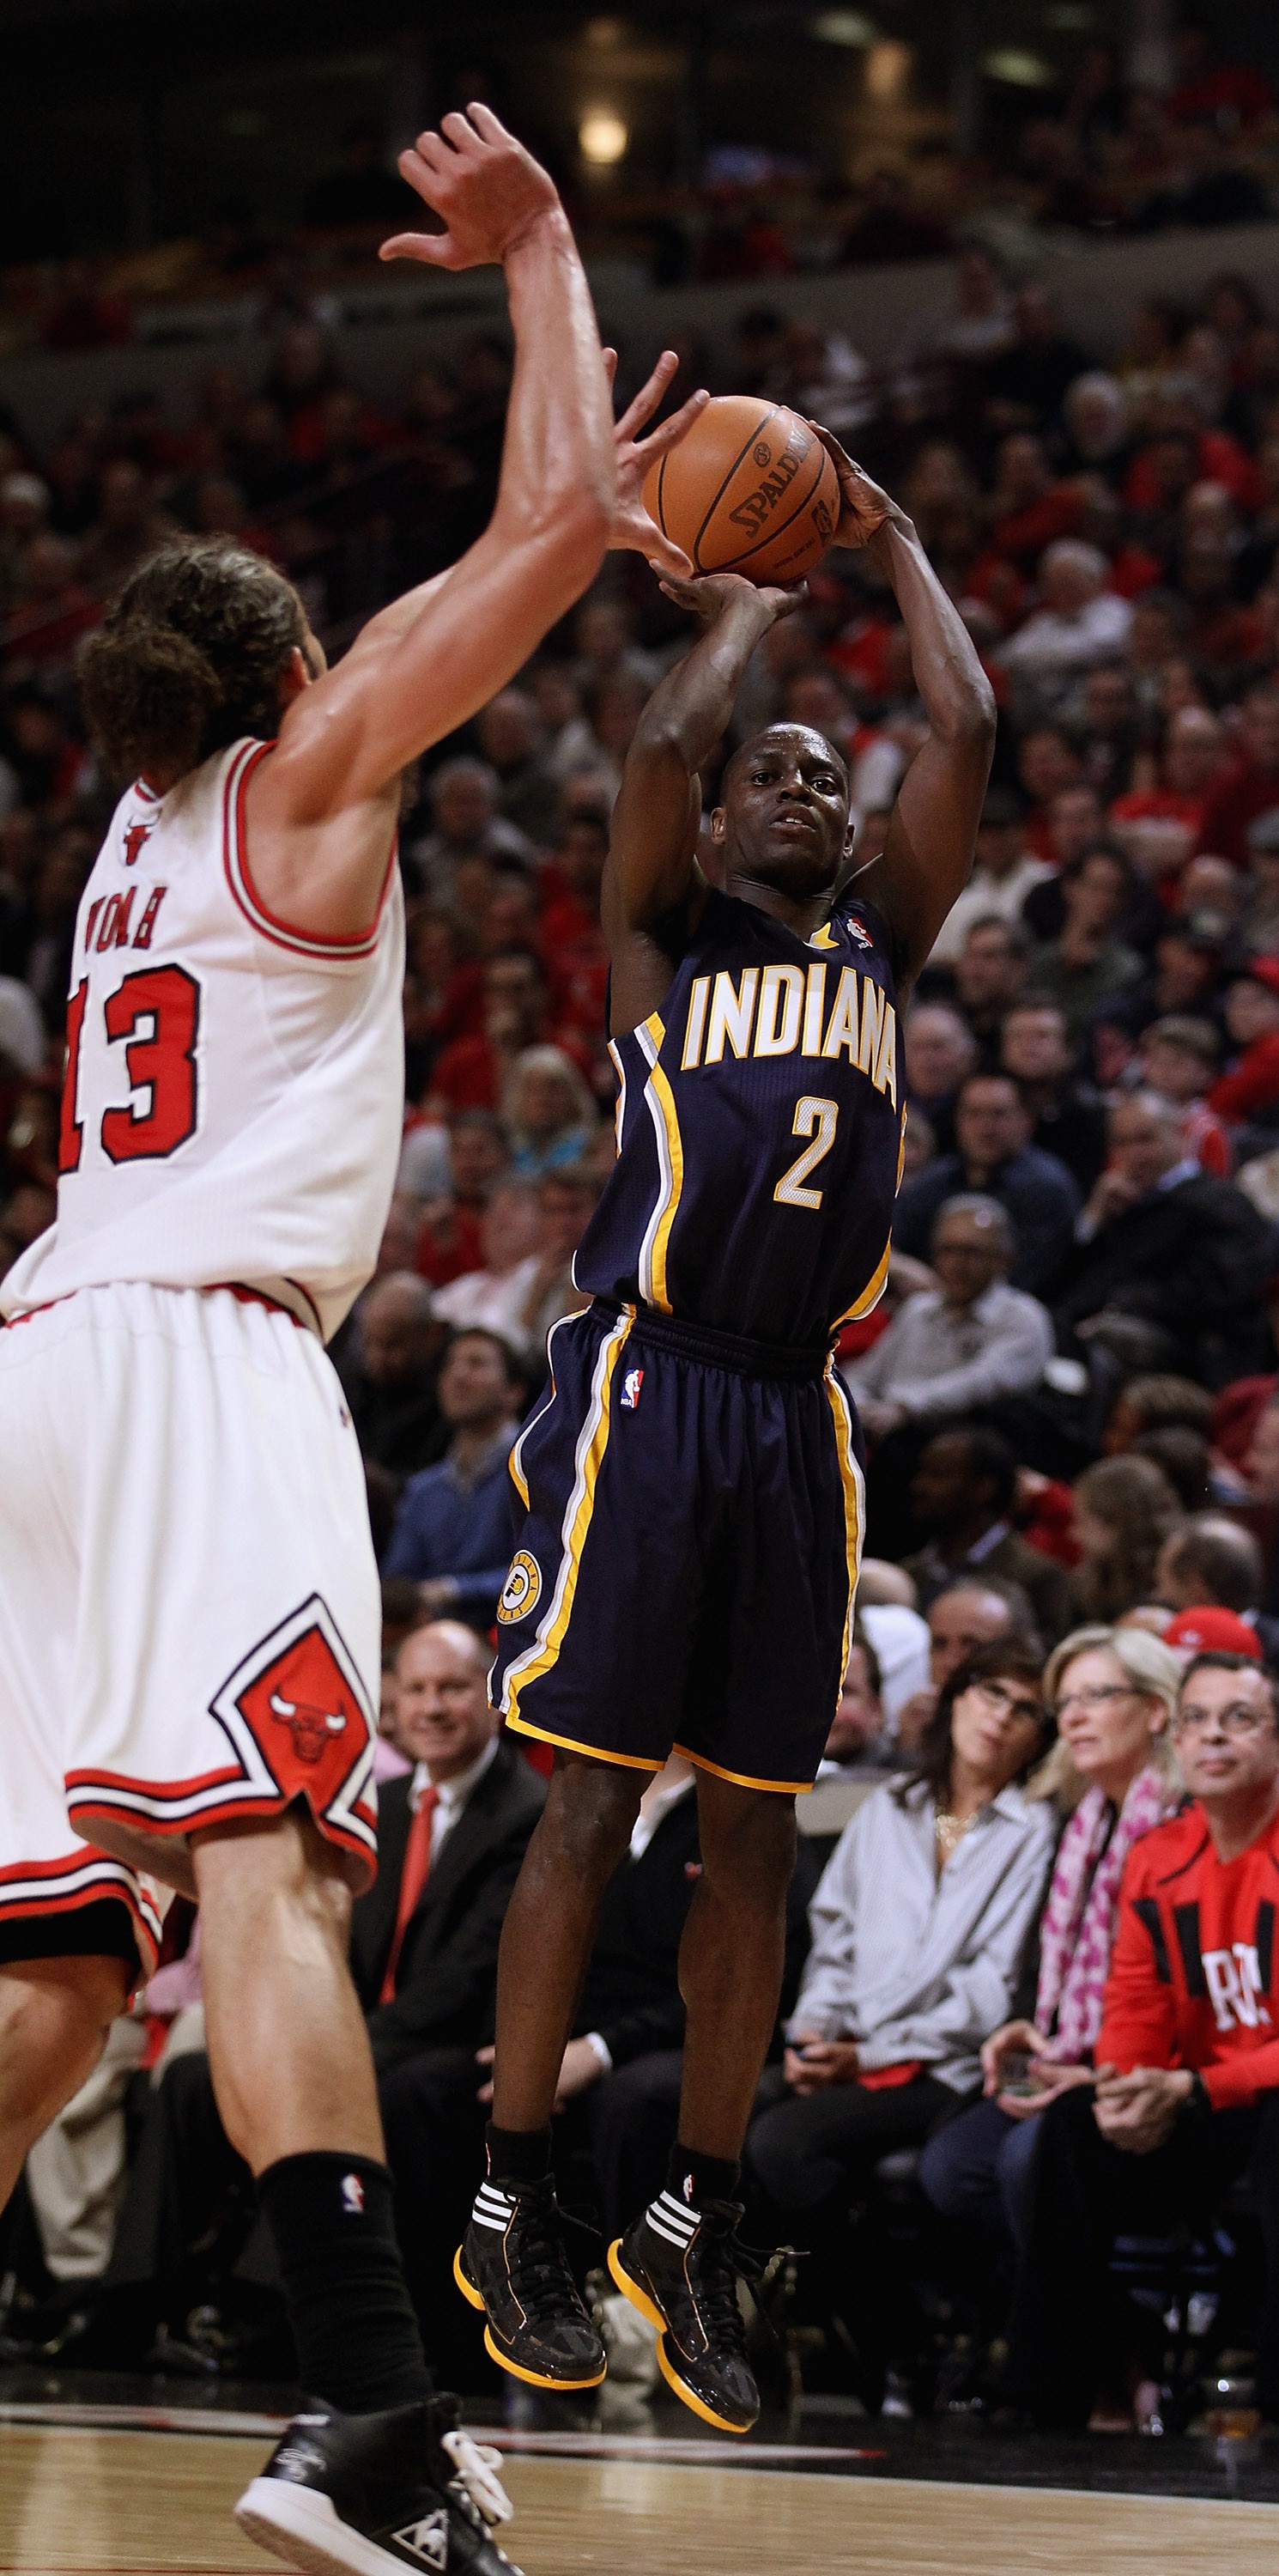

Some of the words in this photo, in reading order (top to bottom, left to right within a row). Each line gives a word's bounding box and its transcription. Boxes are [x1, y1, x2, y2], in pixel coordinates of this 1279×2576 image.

[58, 962, 202, 1176] 13
[681, 963, 897, 1115] INDIANA
[773, 1096, 840, 1210] 2
